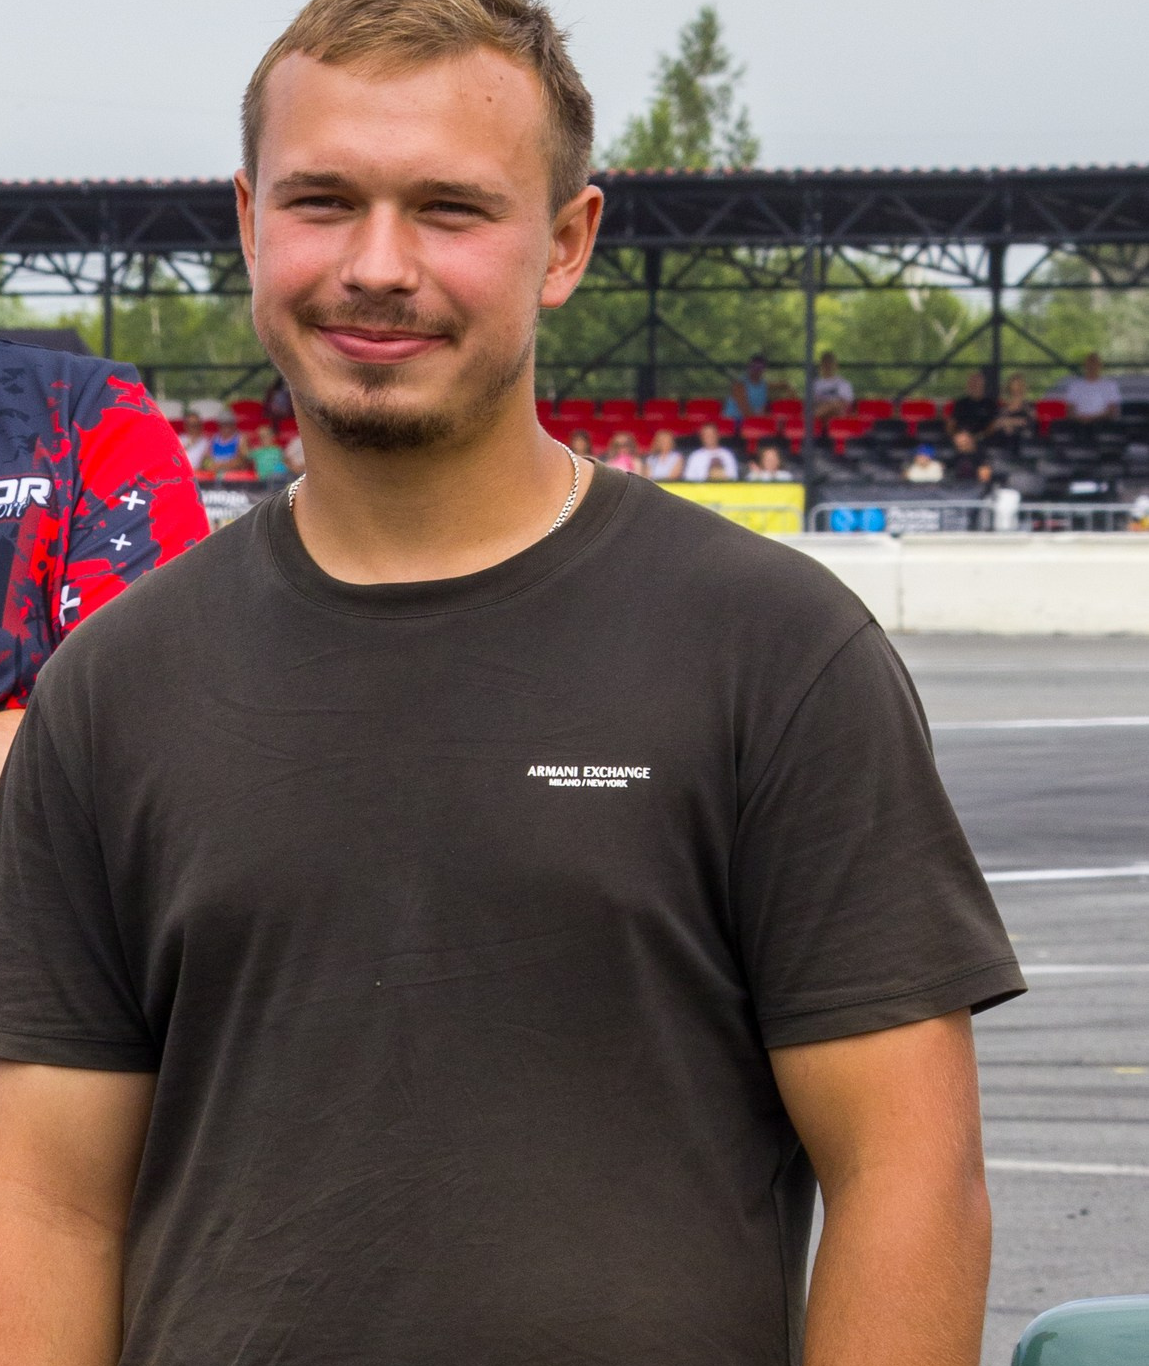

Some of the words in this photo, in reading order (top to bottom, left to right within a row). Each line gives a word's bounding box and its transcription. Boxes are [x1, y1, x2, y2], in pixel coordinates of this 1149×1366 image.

[527, 765, 578, 778] ARMANI
[583, 765, 651, 780] EXCHANGE
[548, 778, 581, 787] MILANO
